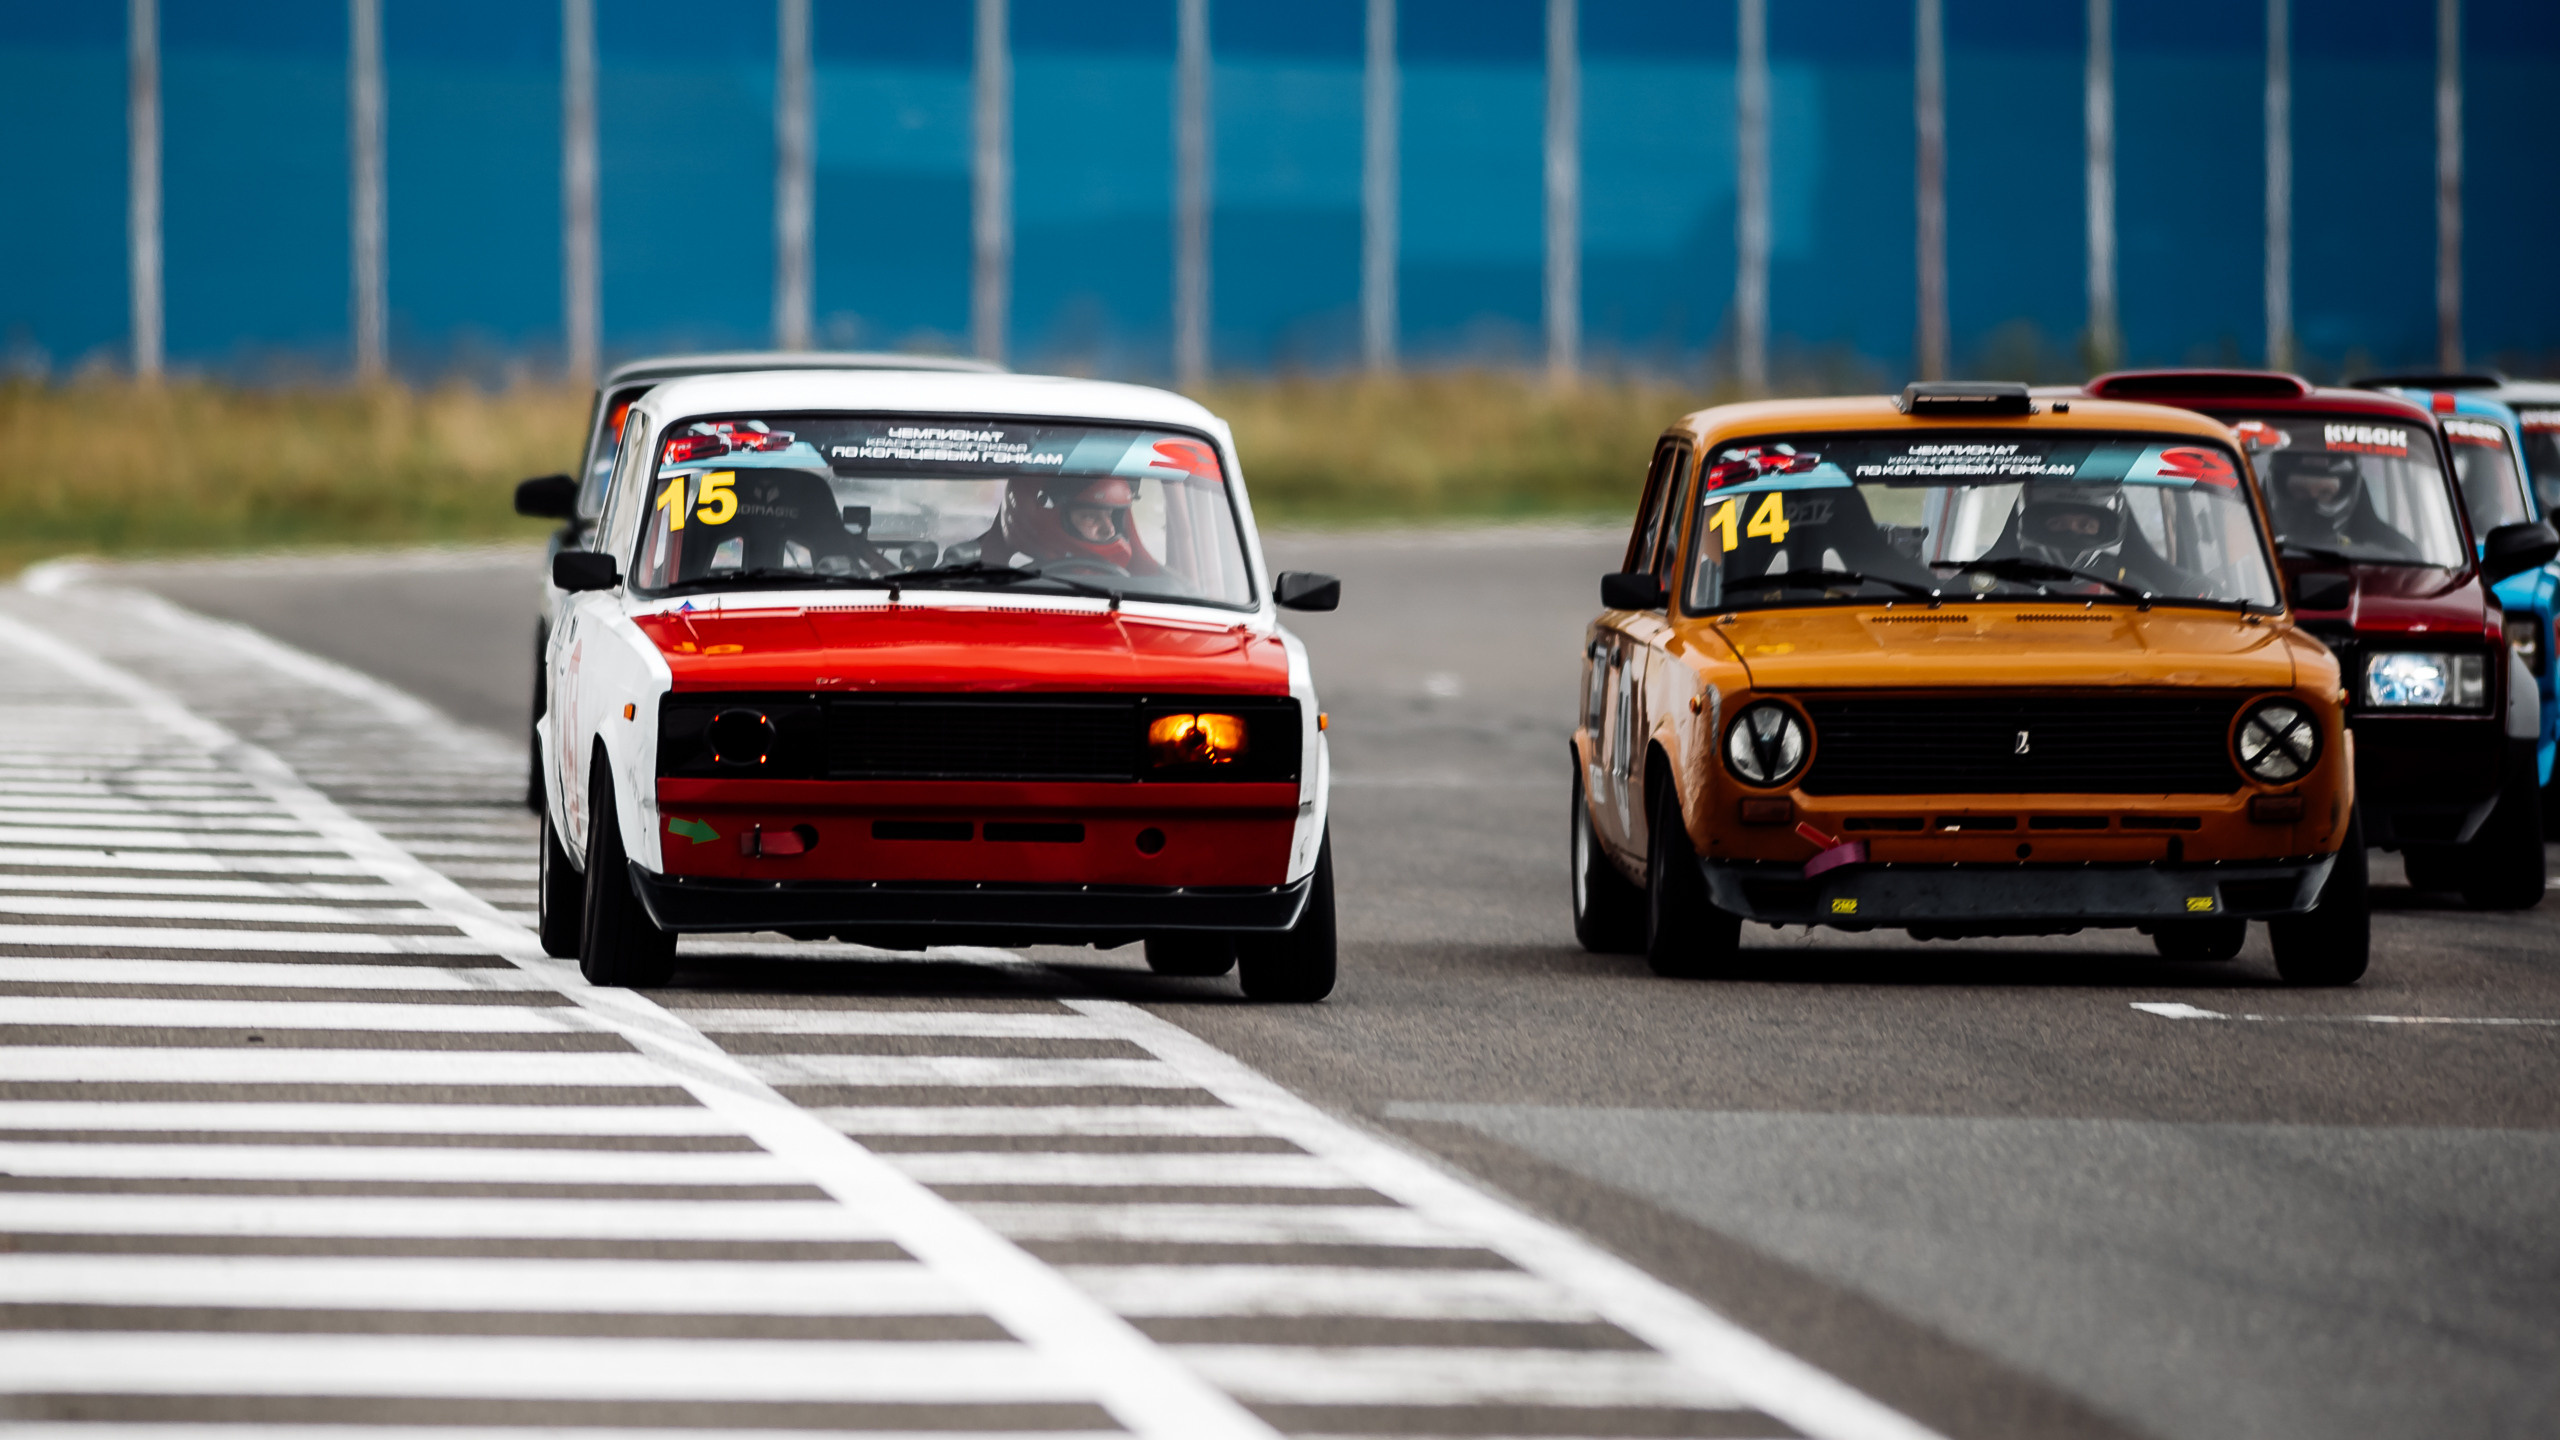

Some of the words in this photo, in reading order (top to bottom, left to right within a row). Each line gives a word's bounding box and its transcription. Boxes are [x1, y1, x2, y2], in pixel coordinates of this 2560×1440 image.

[889, 427, 1005, 443] ЧЕМПИОНАТ
[2324, 424, 2407, 448] КУБОК
[832, 446, 858, 458] ПО
[860, 447, 979, 463] КОЛЬЦЕВЫМ
[981, 451, 1064, 466] ГОНКАМ
[1909, 445, 2020, 456] ЧЕМПИОНАТ
[1856, 464, 1882, 476] ПО
[1883, 464, 1997, 476] КОЛЬЦЕВЫМ
[1999, 464, 2076, 476] ГОНКАМ
[657, 471, 738, 532] 15
[1709, 492, 1790, 552] 14
